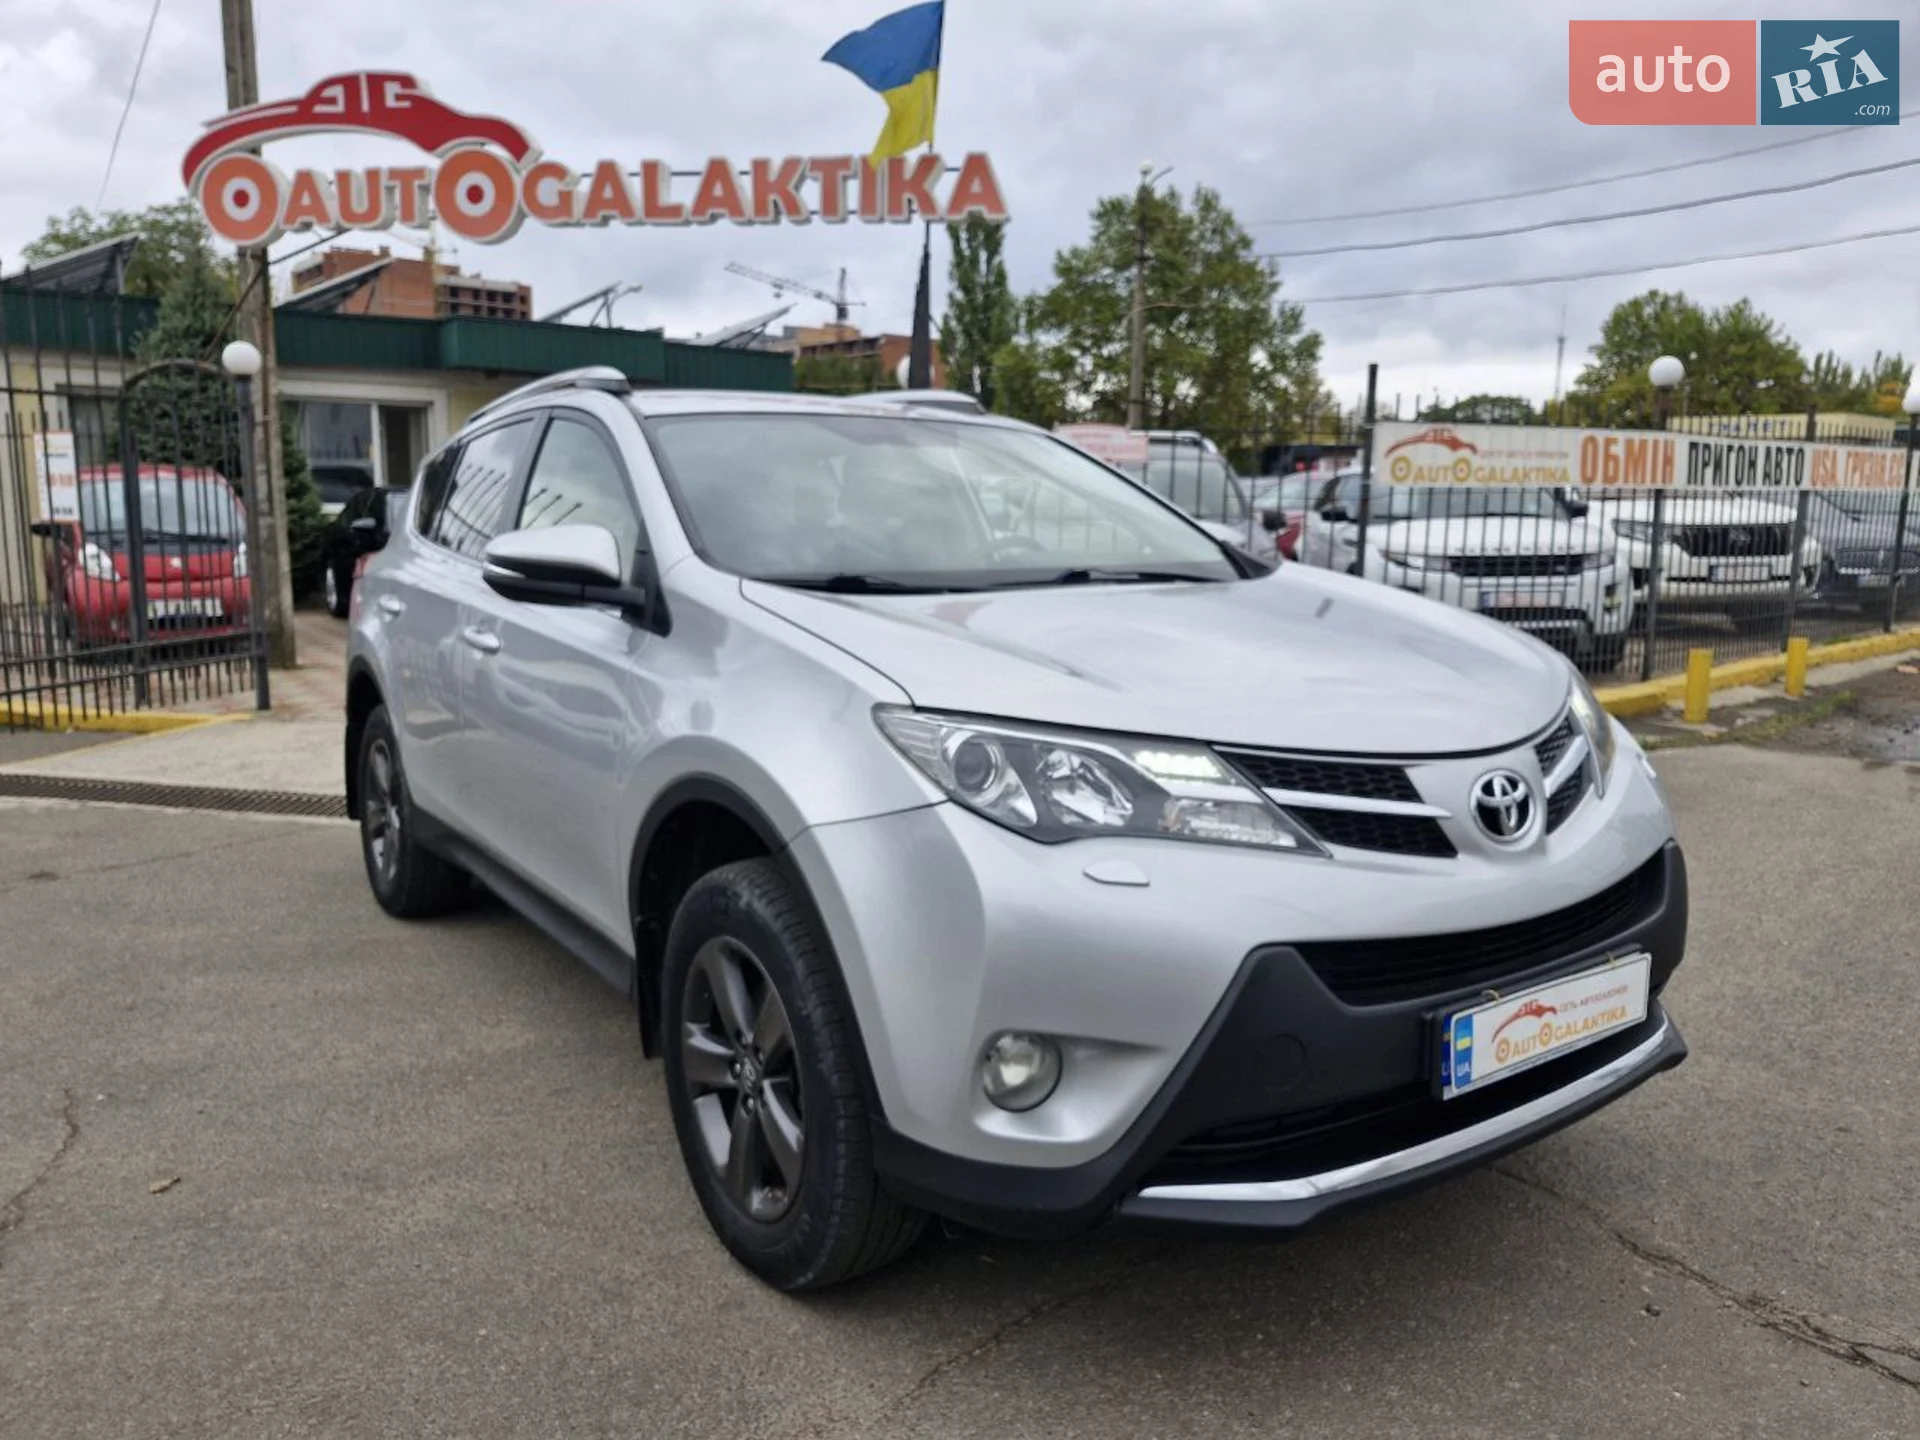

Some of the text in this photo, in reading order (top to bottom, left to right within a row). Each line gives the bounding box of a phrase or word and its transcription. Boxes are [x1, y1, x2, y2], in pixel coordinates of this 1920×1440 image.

[1580, 434, 1677, 485] ОБМІН
[1686, 441, 1758, 487] ПРИГОН
[1762, 446, 1806, 487] АВТО
